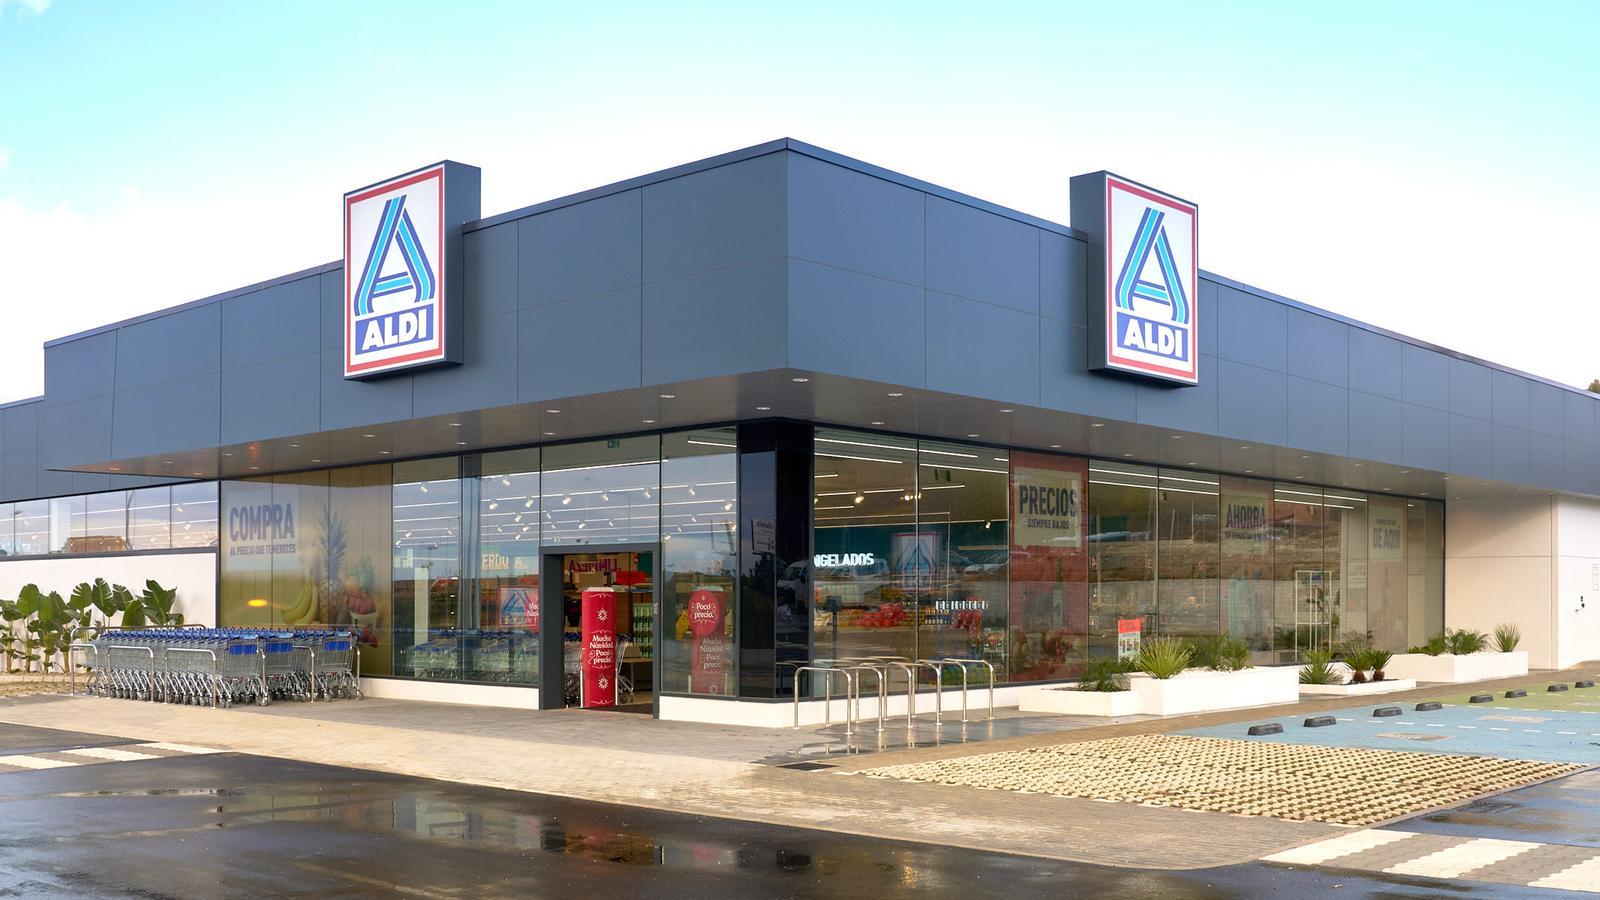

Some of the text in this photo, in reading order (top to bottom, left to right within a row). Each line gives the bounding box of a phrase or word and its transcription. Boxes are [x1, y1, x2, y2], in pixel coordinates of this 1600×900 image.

[361, 308, 427, 351] ALDI
[1123, 318, 1183, 359] ALDI
[1019, 485, 1078, 518] PRECIOS
[1225, 503, 1266, 529] AHORRA
[229, 502, 295, 542] COMPRA
[1027, 518, 1070, 530] SIEMPRE BAJOS
[237, 546, 254, 556] PRECIO
[696, 602, 711, 610] Poco
